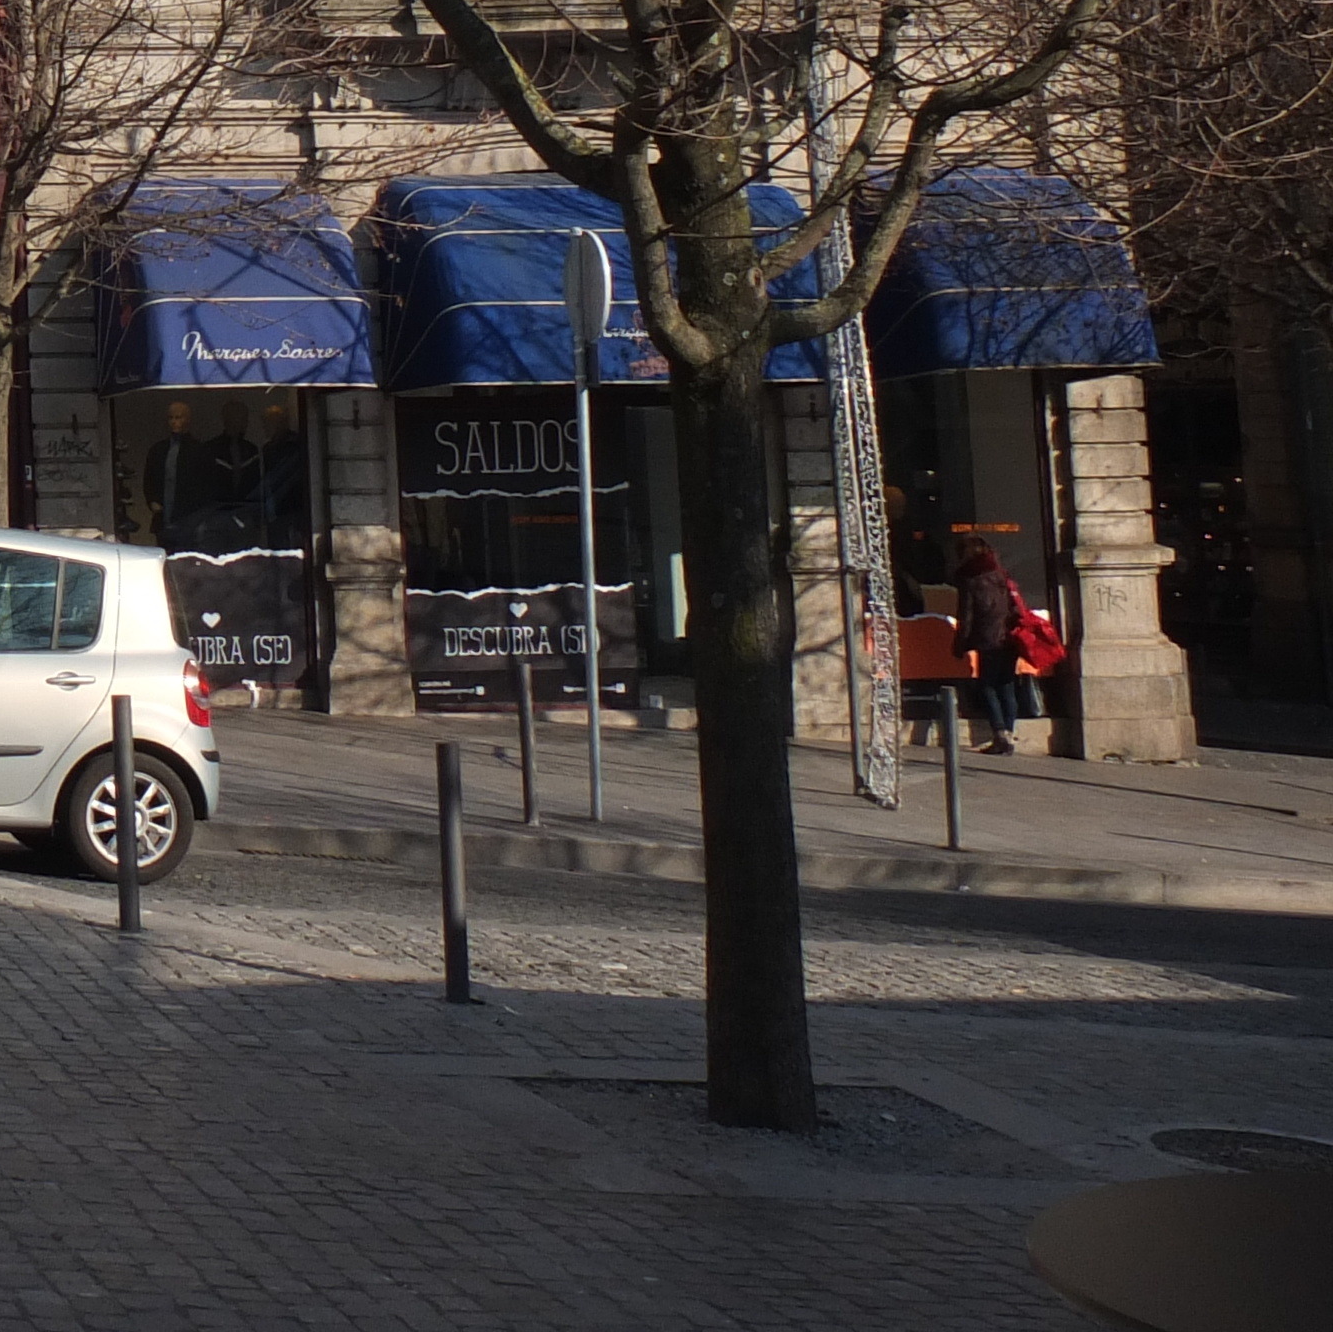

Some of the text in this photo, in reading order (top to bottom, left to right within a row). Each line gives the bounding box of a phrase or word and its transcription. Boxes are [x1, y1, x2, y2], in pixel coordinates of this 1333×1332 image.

[181, 330, 345, 362] Marques Soares
[434, 419, 579, 475] SALDOS
[189, 634, 292, 665] UBRA (SE)
[443, 625, 601, 657] DESCUBRA (S)
